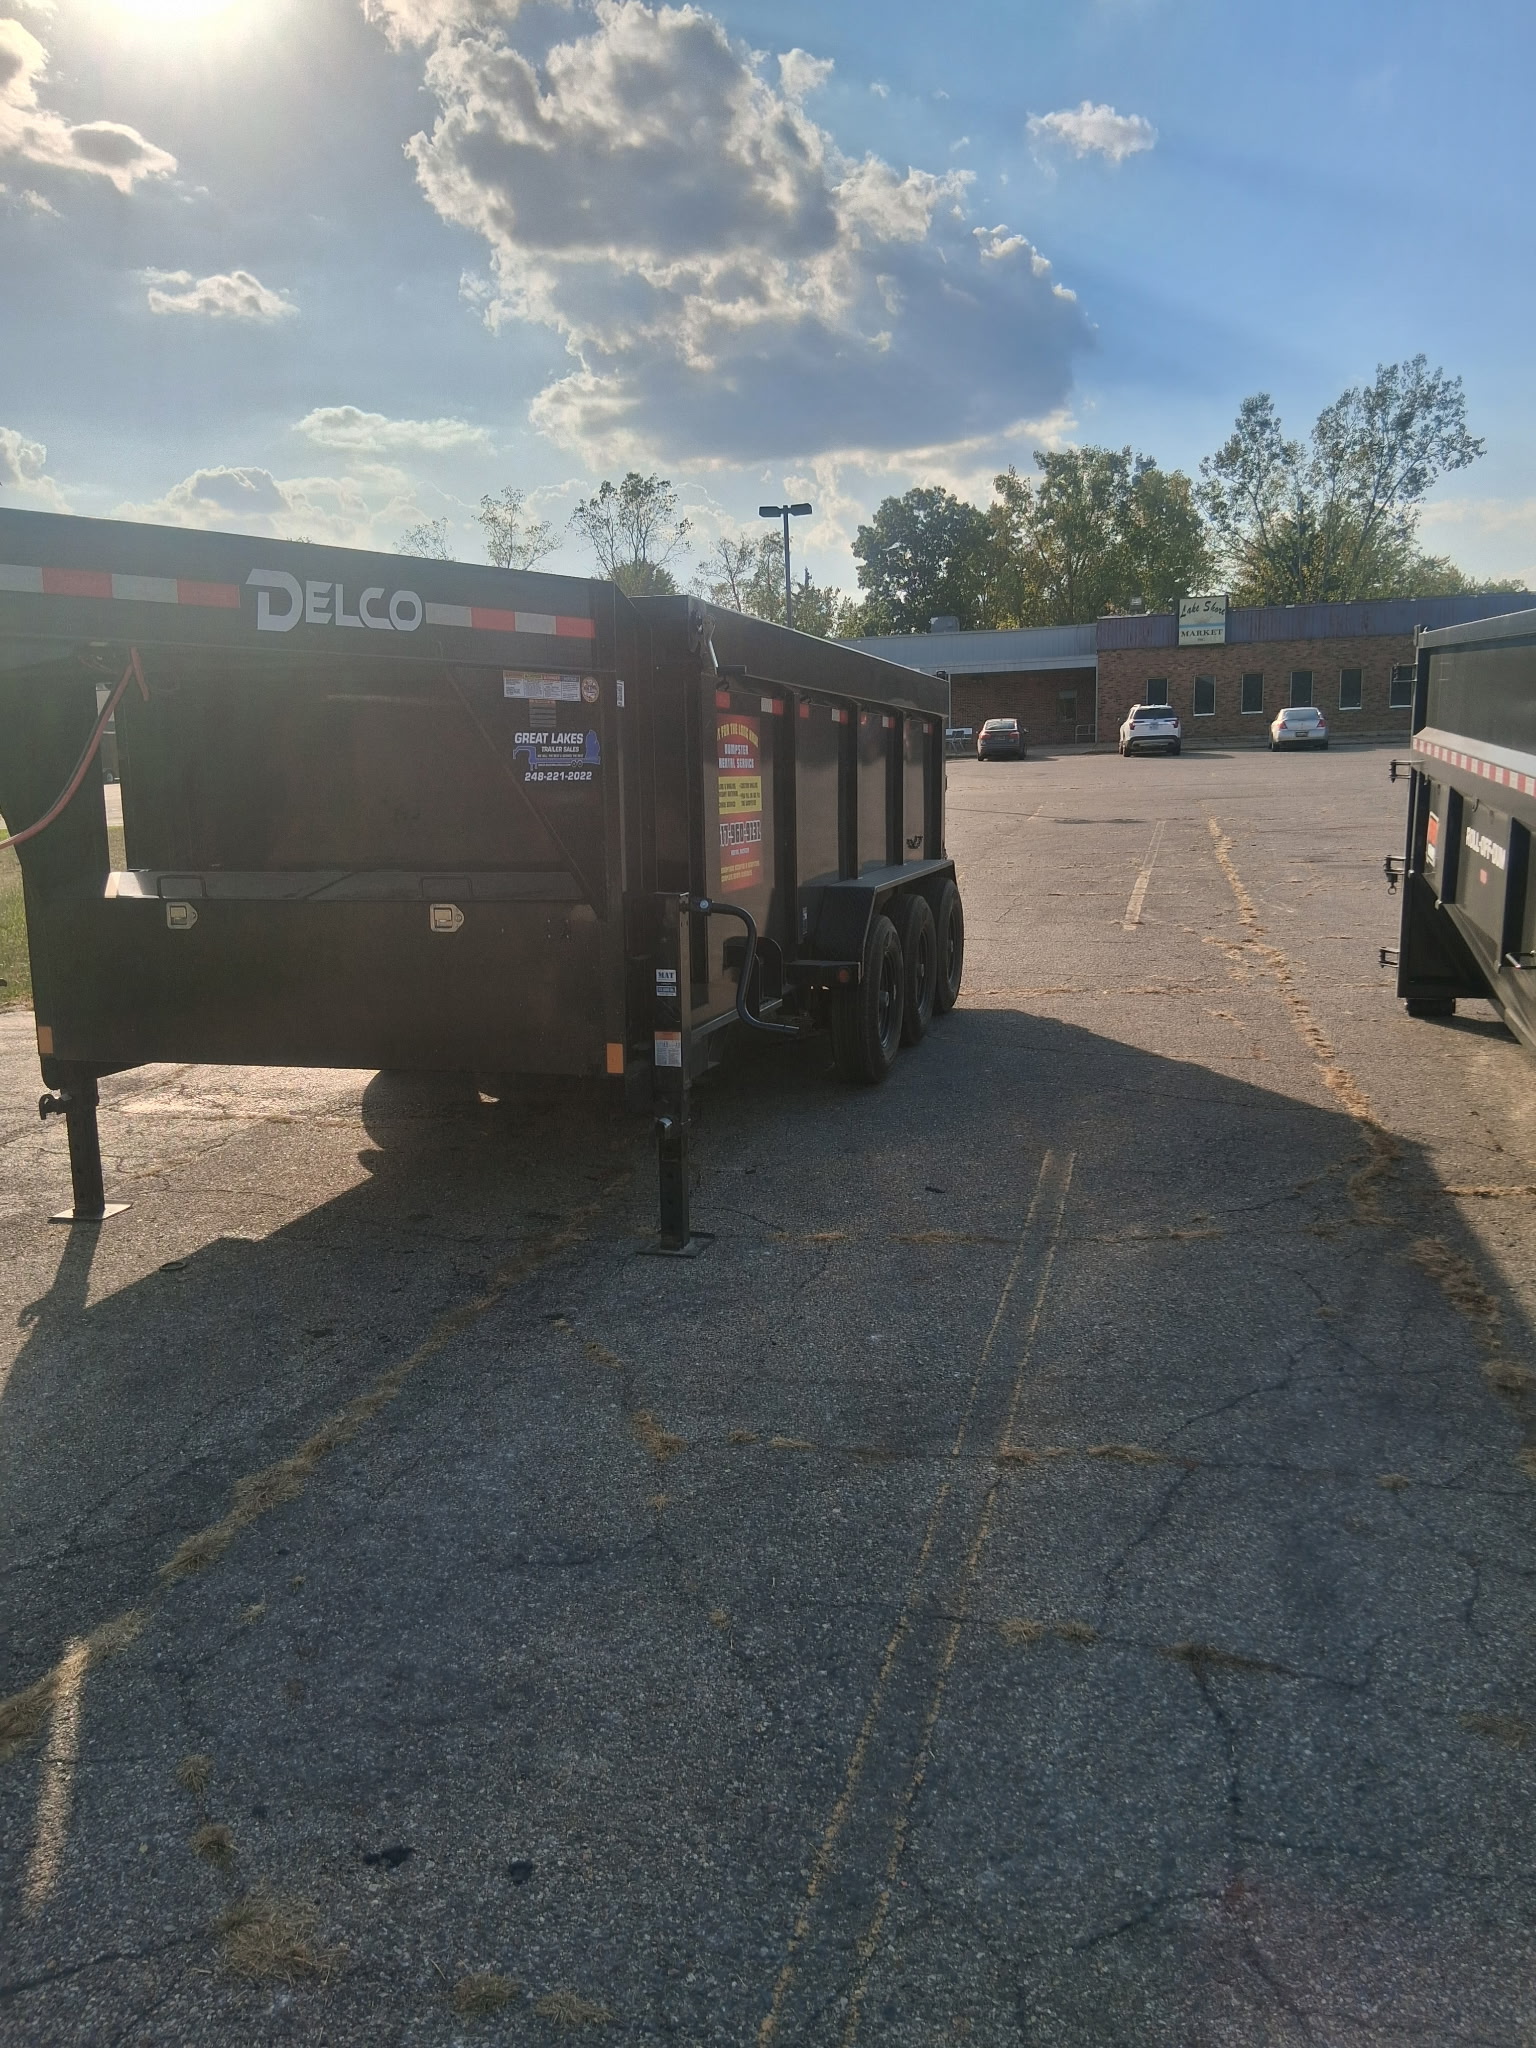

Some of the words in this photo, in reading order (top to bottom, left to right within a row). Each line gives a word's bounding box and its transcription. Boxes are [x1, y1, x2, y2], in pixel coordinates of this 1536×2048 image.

[246, 568, 423, 632] DELCO
[1180, 603, 1200, 618] Lake
[1203, 601, 1226, 615] Shore
[1181, 629, 1223, 637] MARKET
[514, 732, 549, 744] GREAT
[551, 732, 584, 744] LAKES
[724, 743, 749, 755] DUMPSTER
[736, 758, 755, 769] SERVICE
[524, 771, 592, 782] 248-221-2022
